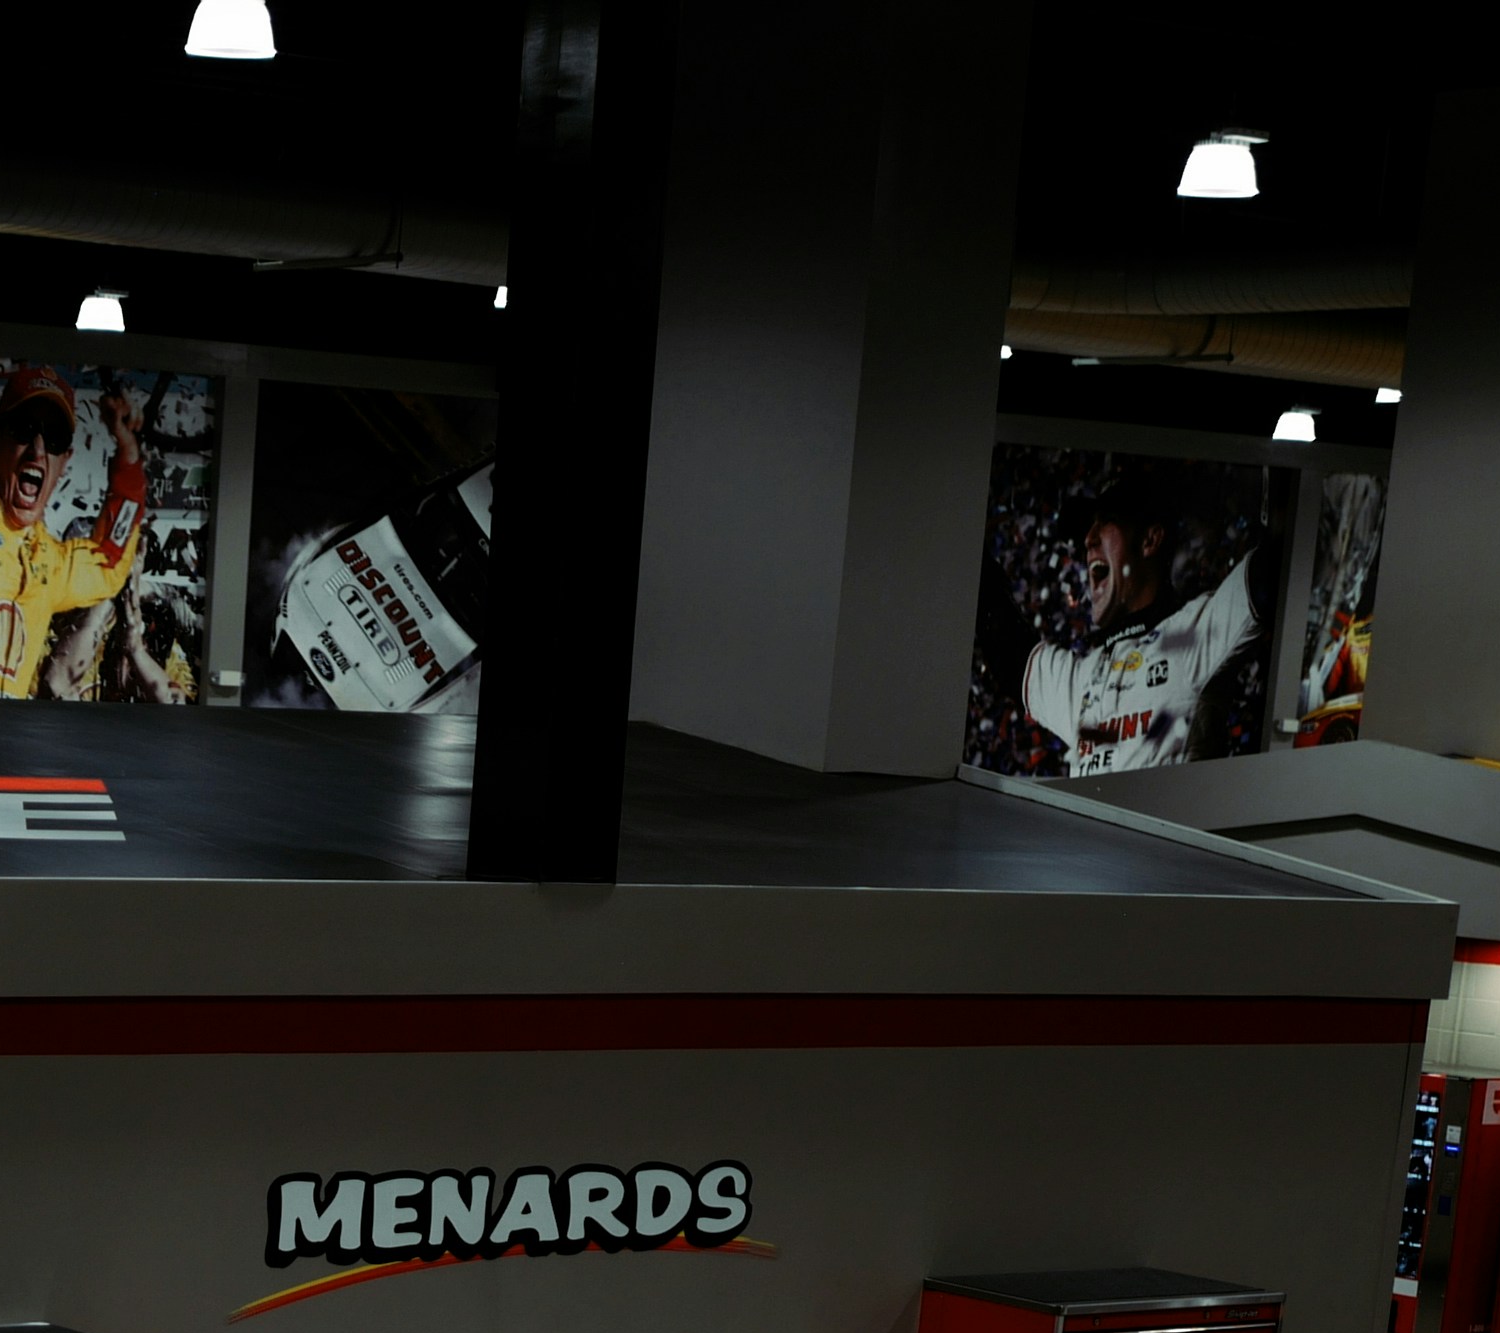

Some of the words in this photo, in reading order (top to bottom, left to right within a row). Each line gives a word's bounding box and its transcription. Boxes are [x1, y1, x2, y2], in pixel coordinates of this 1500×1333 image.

[334, 539, 446, 687] DISCOUNT
[344, 589, 398, 657] TIRE
[392, 560, 436, 621] tires.com
[317, 629, 348, 676] PENNZOIL
[270, 1163, 751, 1262] MENARDS
